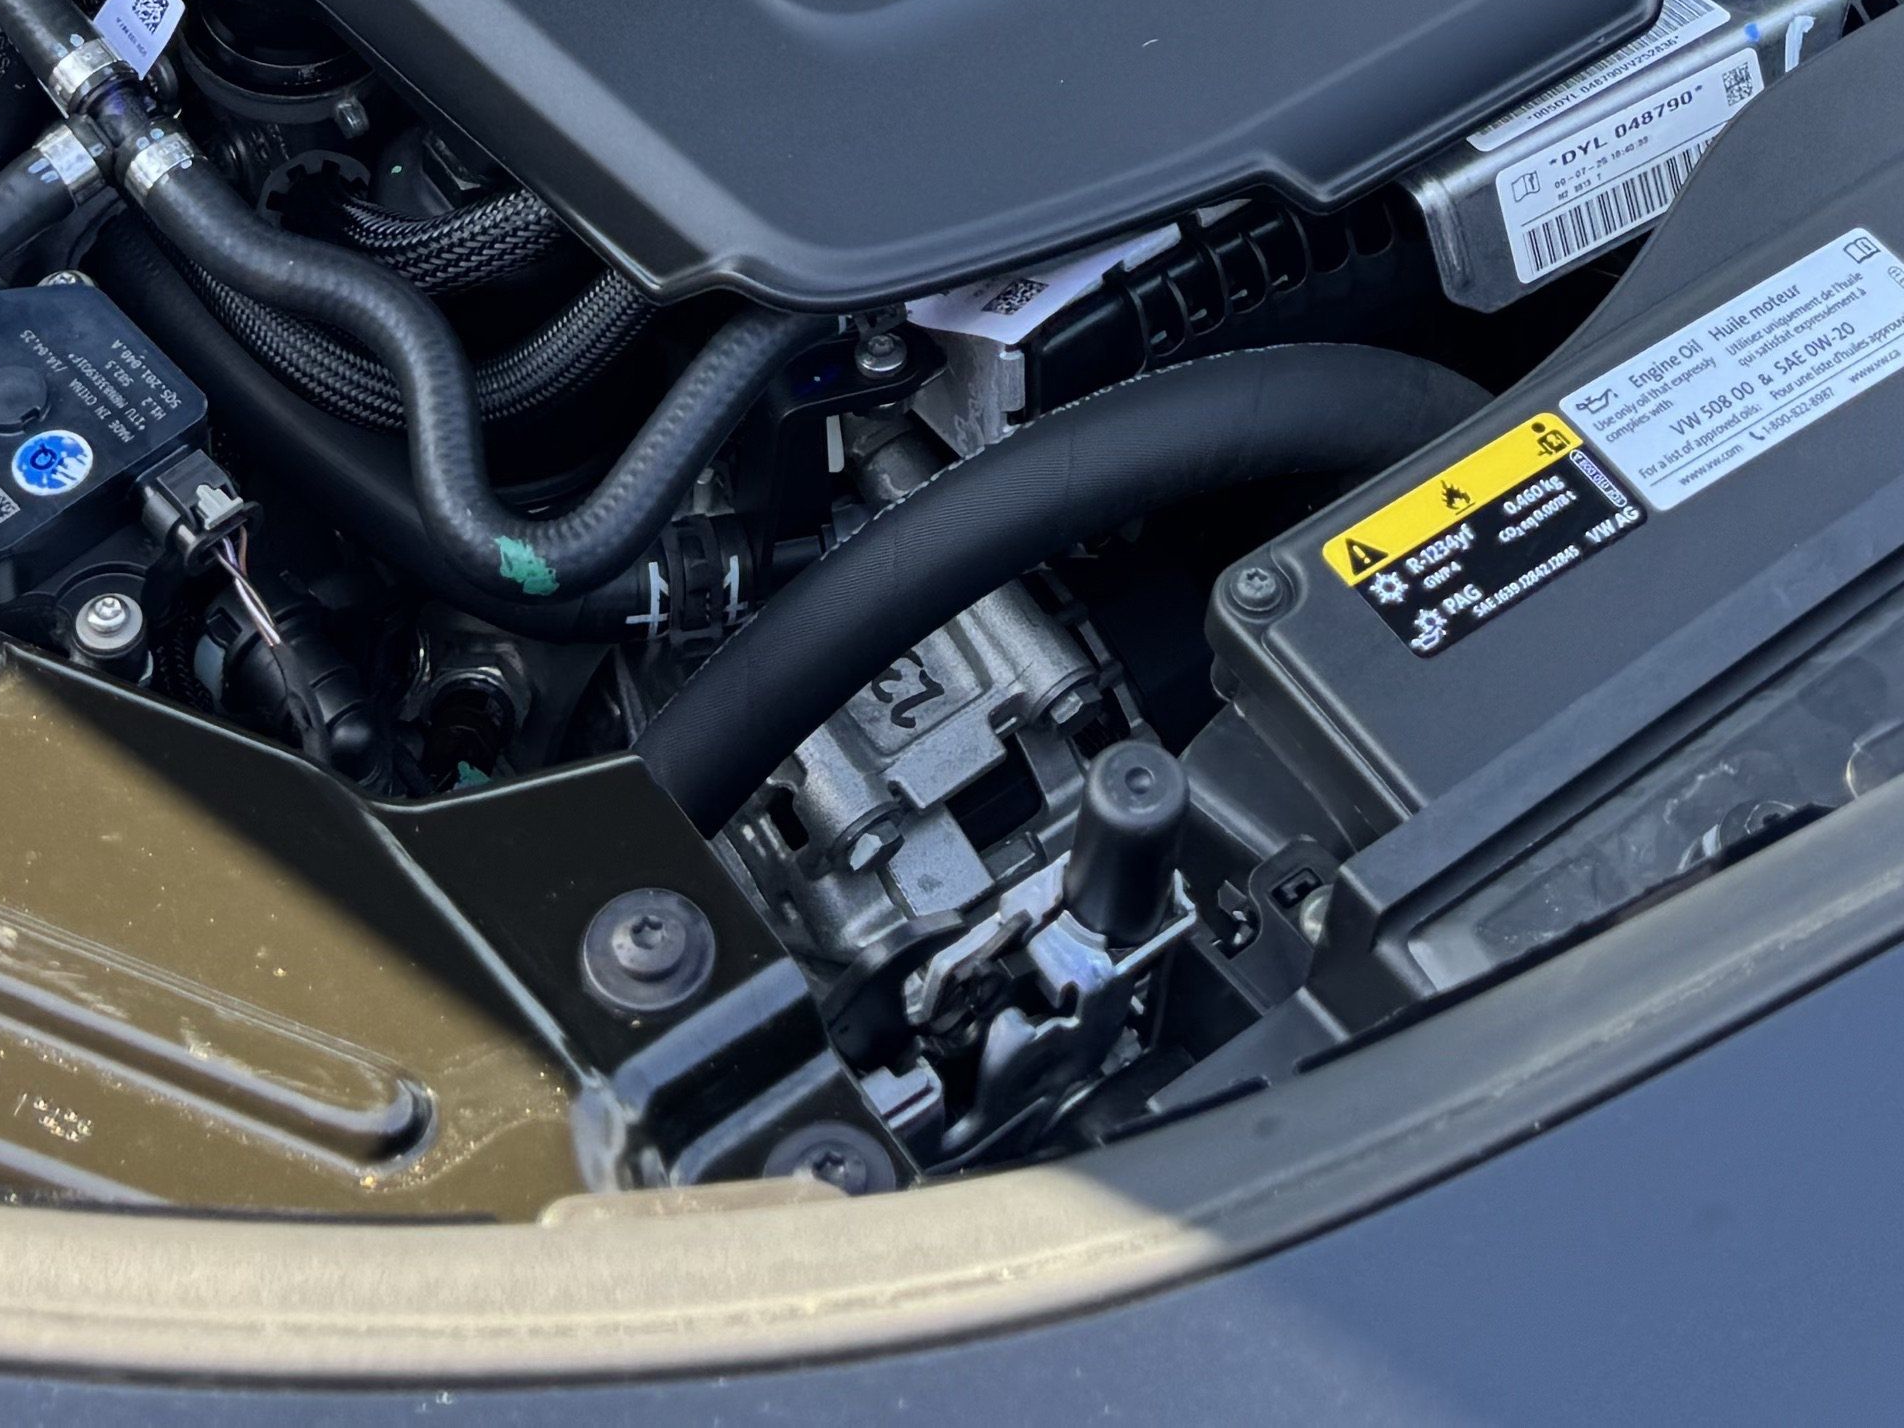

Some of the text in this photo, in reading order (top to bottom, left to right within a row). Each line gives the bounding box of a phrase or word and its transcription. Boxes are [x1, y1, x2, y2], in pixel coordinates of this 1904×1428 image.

[1708, 285, 1800, 341] Huile moteur
[1725, 273, 1863, 355] Utilisez uniquement de l'huile
[1738, 287, 1866, 367] qui satisfait expressément à
[1628, 339, 1703, 388] Engine Oil
[1669, 322, 1855, 435] VW 508 00 & SAE 0W-20
[1770, 383, 1794, 400] Pour
[1793, 372, 1815, 387] une
[1811, 360, 1834, 376] liste
[1833, 339, 1869, 364] d'huiles
[68, 377, 98, 407] CHINA
[93, 403, 111, 420] IN
[1593, 357, 1716, 431] Use only oil that expressly
[108, 418, 134, 443] MADE
[1606, 400, 1674, 443] complies with
[1639, 404, 1762, 479] For a list of approved oils:
[1679, 445, 1744, 485] www.vw.com
[1848, 350, 1901, 383] www.vw.ca
[1504, 476, 1565, 514] 0.460 kg
[1406, 523, 1474, 574] R-1234yf
[1586, 506, 1639, 542] VW AG
[1443, 584, 1482, 614] PAG
[1473, 598, 1496, 617] SAE
